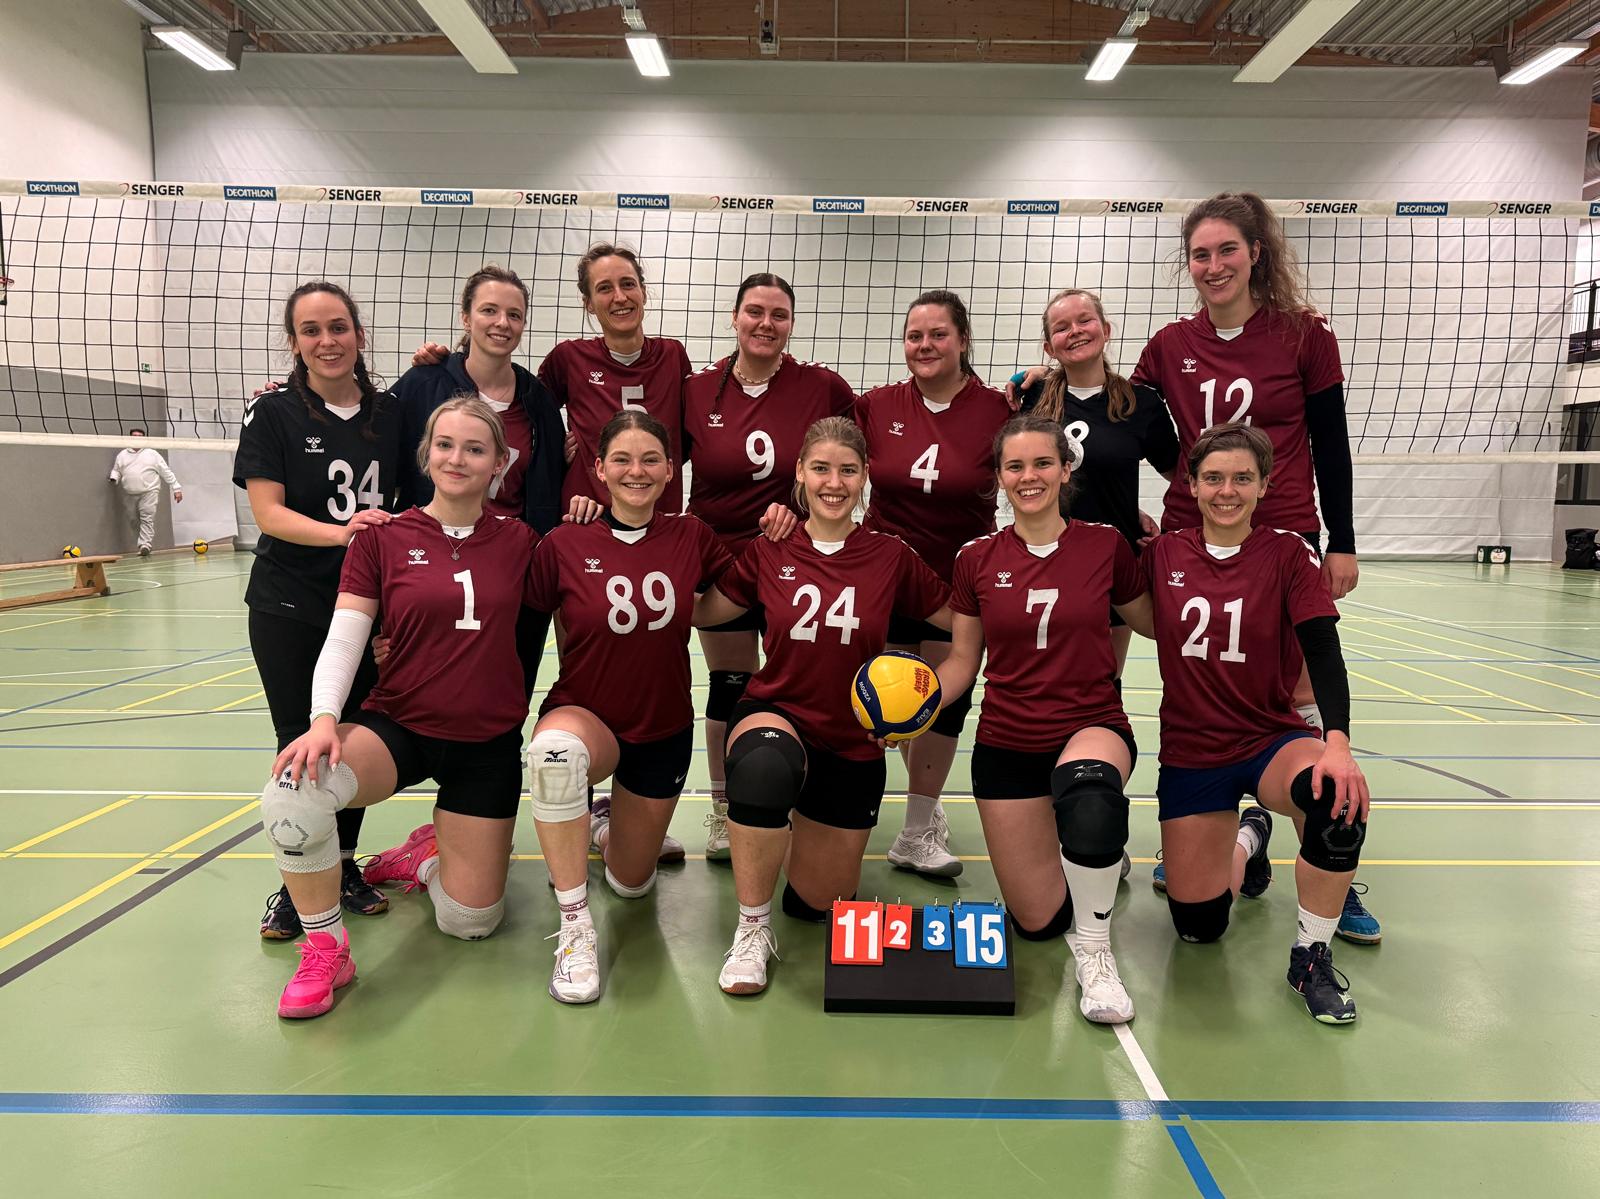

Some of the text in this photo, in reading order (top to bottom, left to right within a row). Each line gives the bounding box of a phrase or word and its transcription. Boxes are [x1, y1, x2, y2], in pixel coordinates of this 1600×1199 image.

[29, 183, 77, 194] DECATHLON
[131, 183, 184, 197] SENGER
[225, 187, 274, 199] DECATHLON
[328, 189, 382, 201] SENGER
[423, 192, 471, 204] DECATHLON
[525, 193, 578, 206] SENGER
[619, 195, 667, 206] DECATHLON
[721, 197, 774, 210] SENGER
[815, 200, 862, 211] DECATHLON
[915, 200, 969, 213] SENGER
[1009, 202, 1057, 213] DECATHLON
[1110, 201, 1164, 213] SENGER
[1304, 202, 1358, 214] SENGER
[1398, 203, 1446, 214] DECATHLON
[1498, 202, 1552, 215] SENGER
[621, 384, 649, 415] 5
[1200, 377, 1255, 435] 12
[745, 430, 775, 481] 9
[909, 444, 940, 494] 4
[327, 458, 384, 521] 34
[453, 569, 481, 630] 1
[606, 570, 676, 634] 89
[790, 583, 860, 645] 24
[1025, 588, 1059, 650] 7
[1180, 596, 1246, 663] 21
[837, 909, 1004, 964] 11 2 3 15
